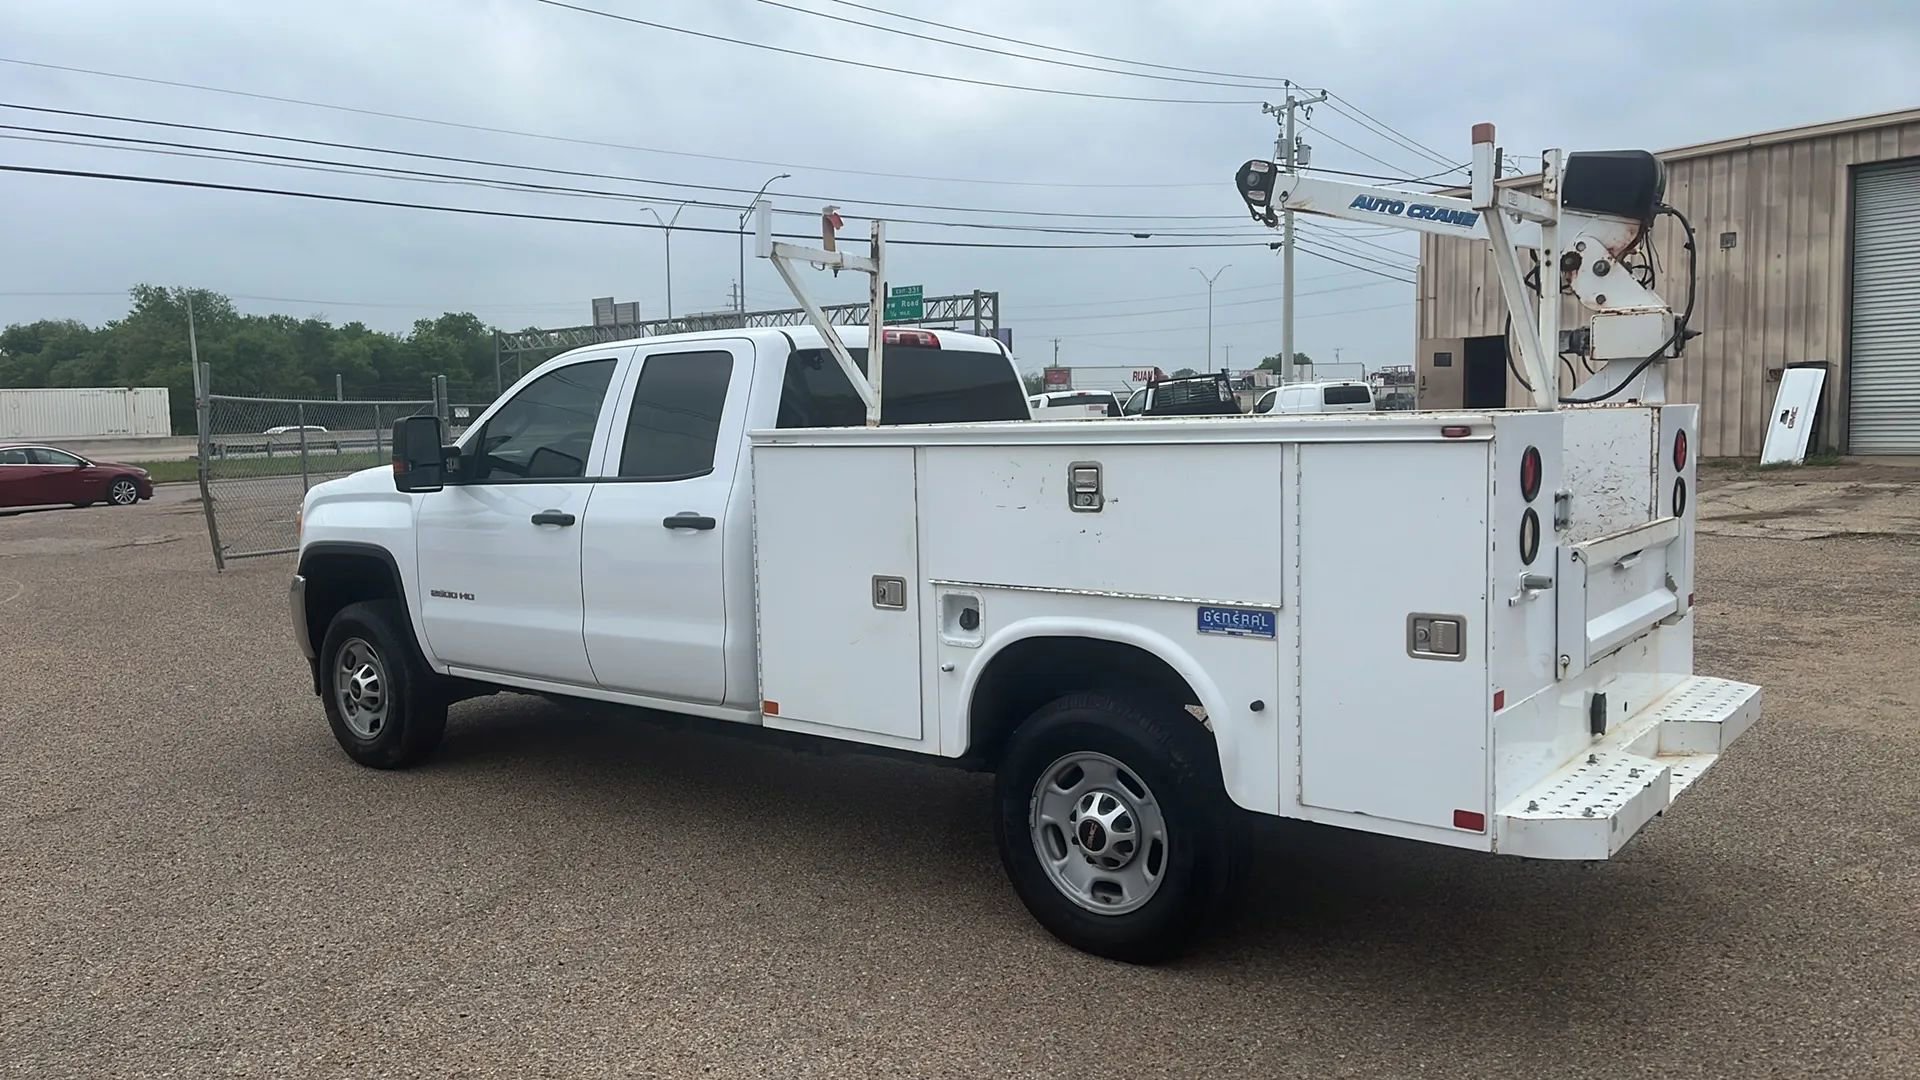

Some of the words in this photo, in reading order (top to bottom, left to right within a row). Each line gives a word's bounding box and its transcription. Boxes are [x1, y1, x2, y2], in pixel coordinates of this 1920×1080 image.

[1349, 194, 1405, 215] AUTO
[1407, 204, 1480, 227] CRANE
[1788, 406, 1799, 429] GMC
[459, 592, 475, 600] HD
[1203, 610, 1269, 627] GENERAL
